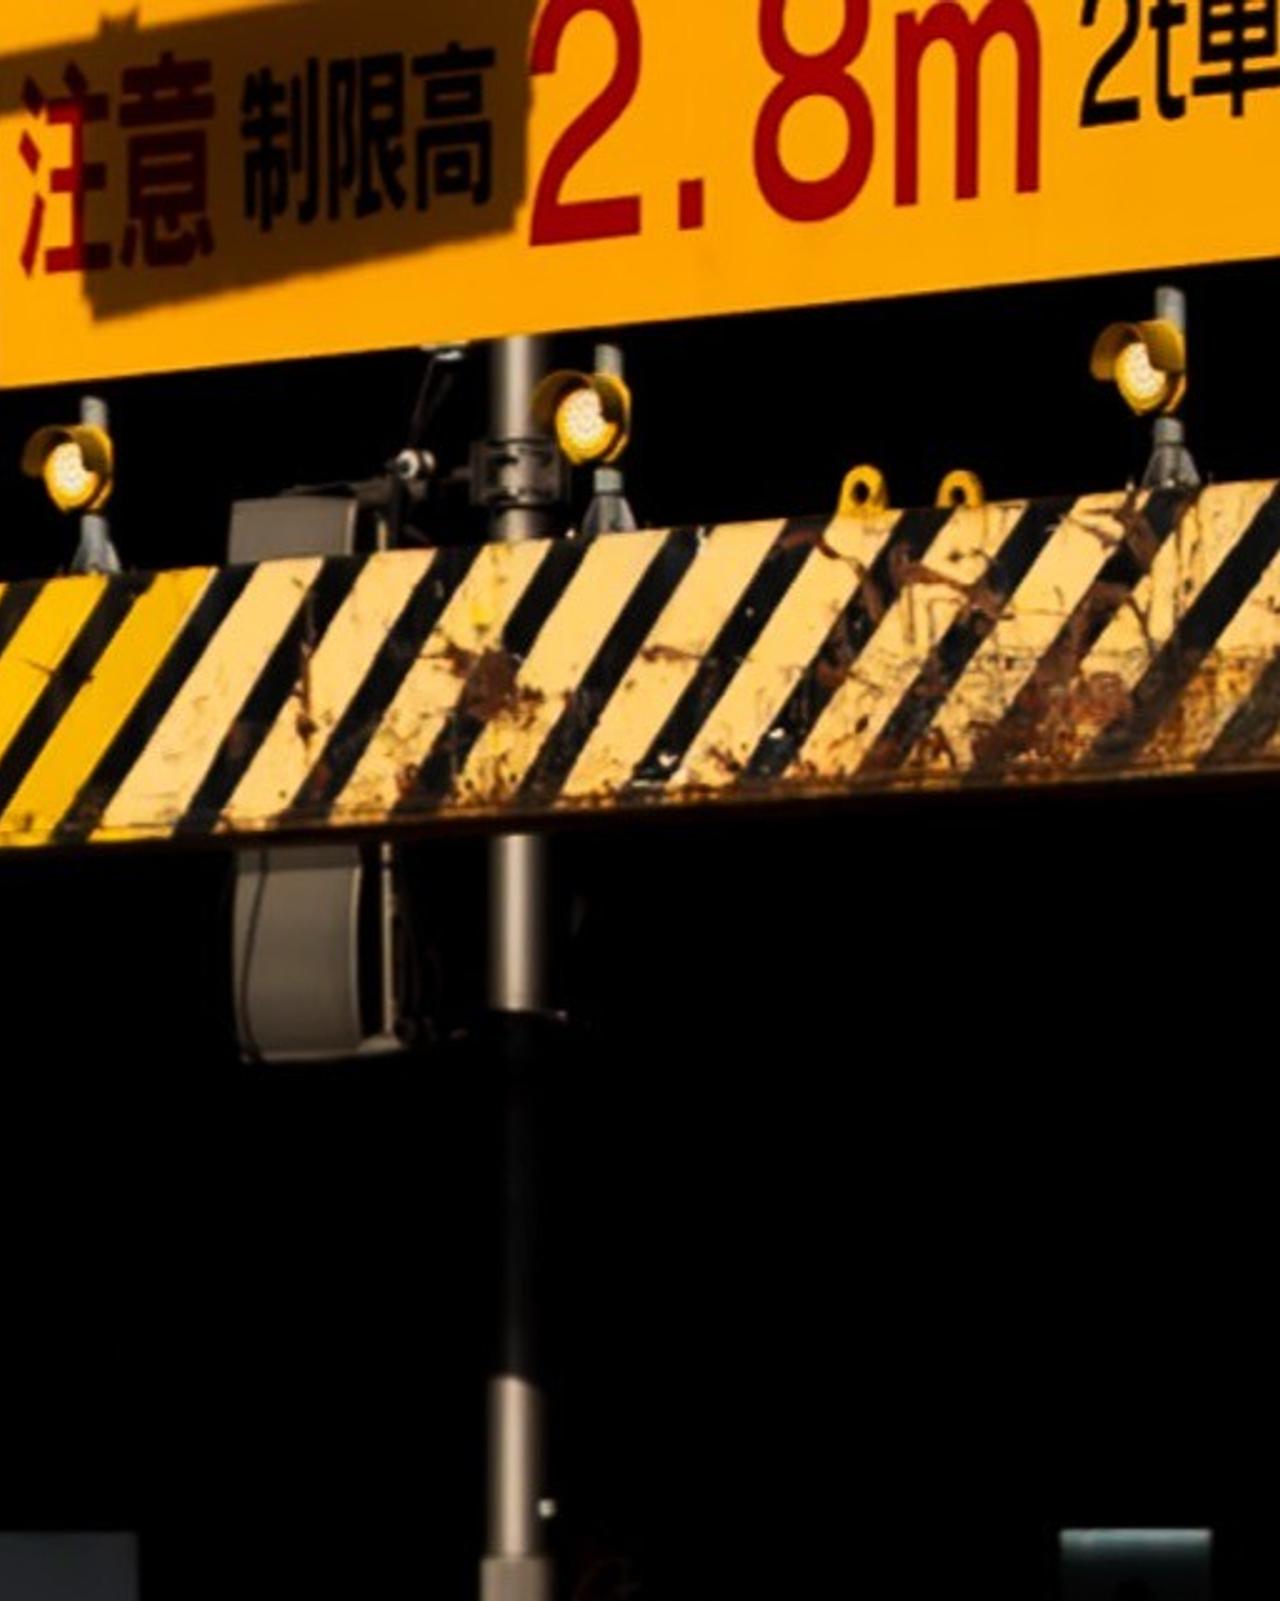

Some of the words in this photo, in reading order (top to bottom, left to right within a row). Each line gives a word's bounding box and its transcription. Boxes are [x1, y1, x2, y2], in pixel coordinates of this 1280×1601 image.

[19, 50, 216, 280] 注意
[240, 40, 497, 233] 制限高
[527, 0, 1041, 248] 2.8m
